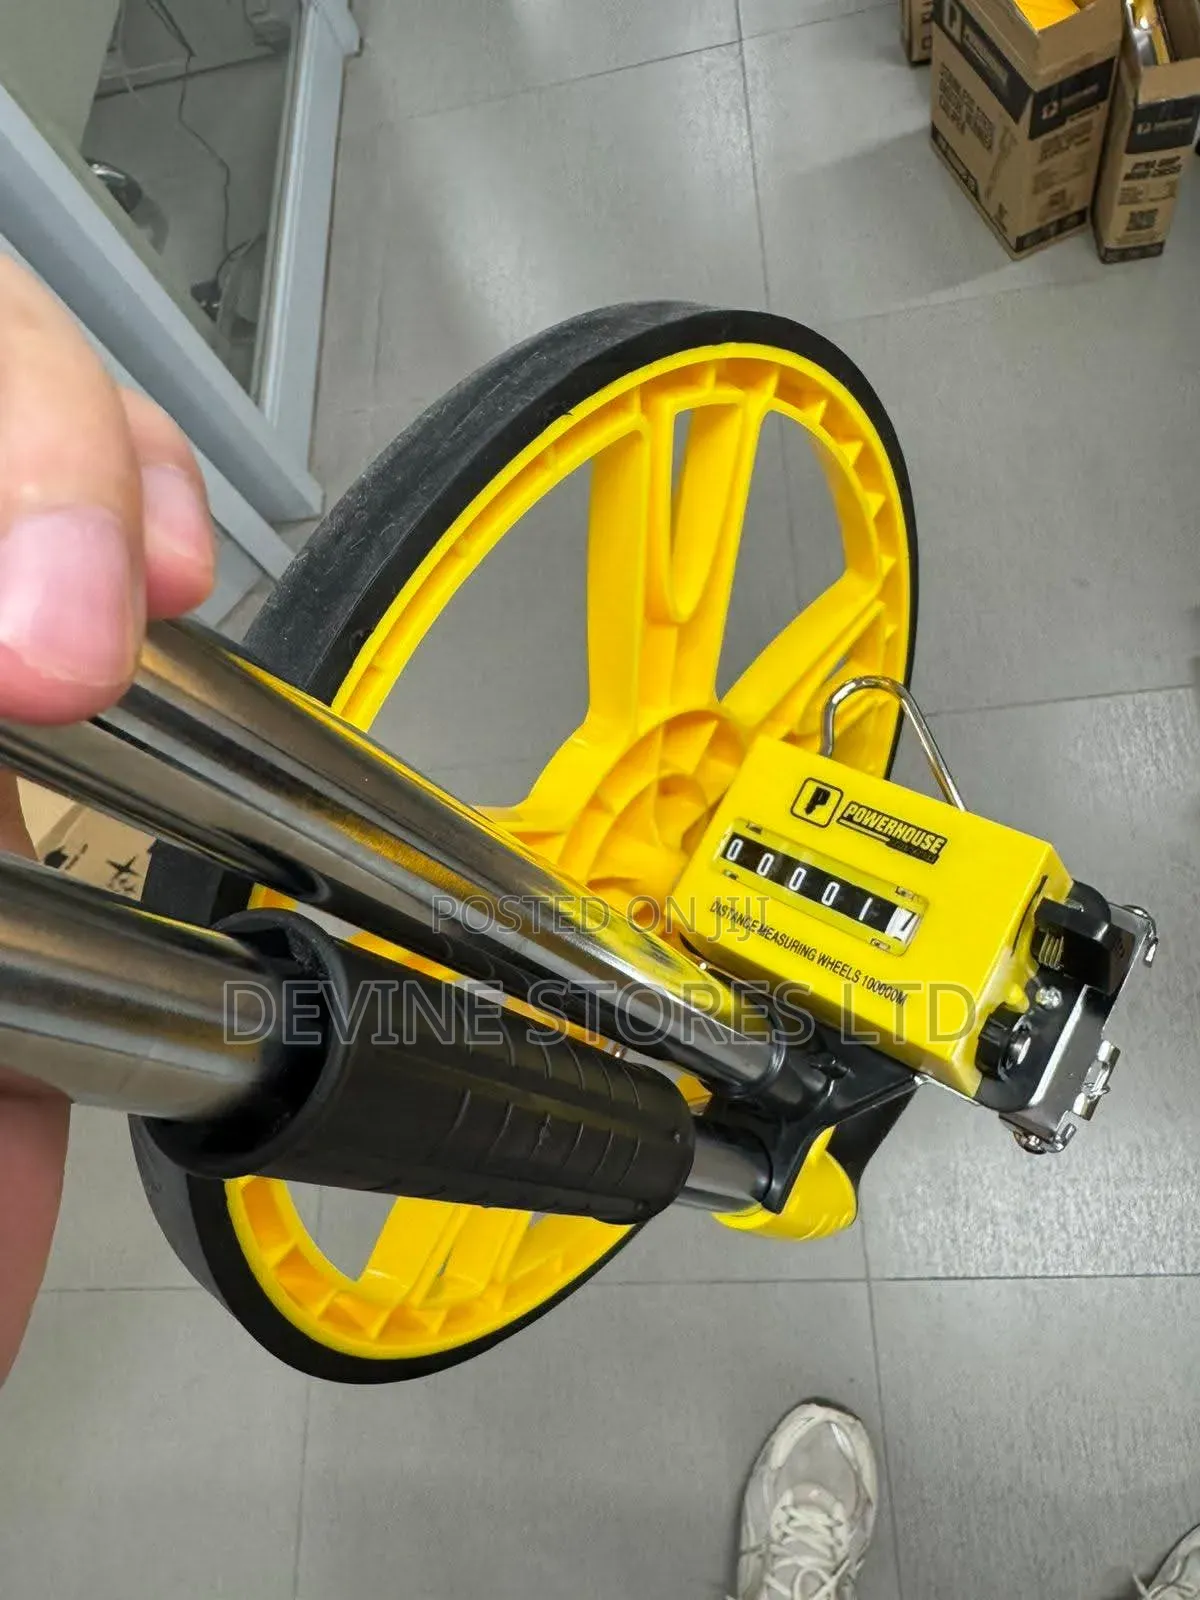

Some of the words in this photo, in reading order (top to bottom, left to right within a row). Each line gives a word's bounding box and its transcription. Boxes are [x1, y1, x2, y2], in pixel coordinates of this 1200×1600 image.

[842, 803, 945, 855] POWERHOUSE
[709, 900, 758, 934] DISTANCE
[757, 923, 816, 961] MEASURING
[817, 953, 861, 984] WHEELS
